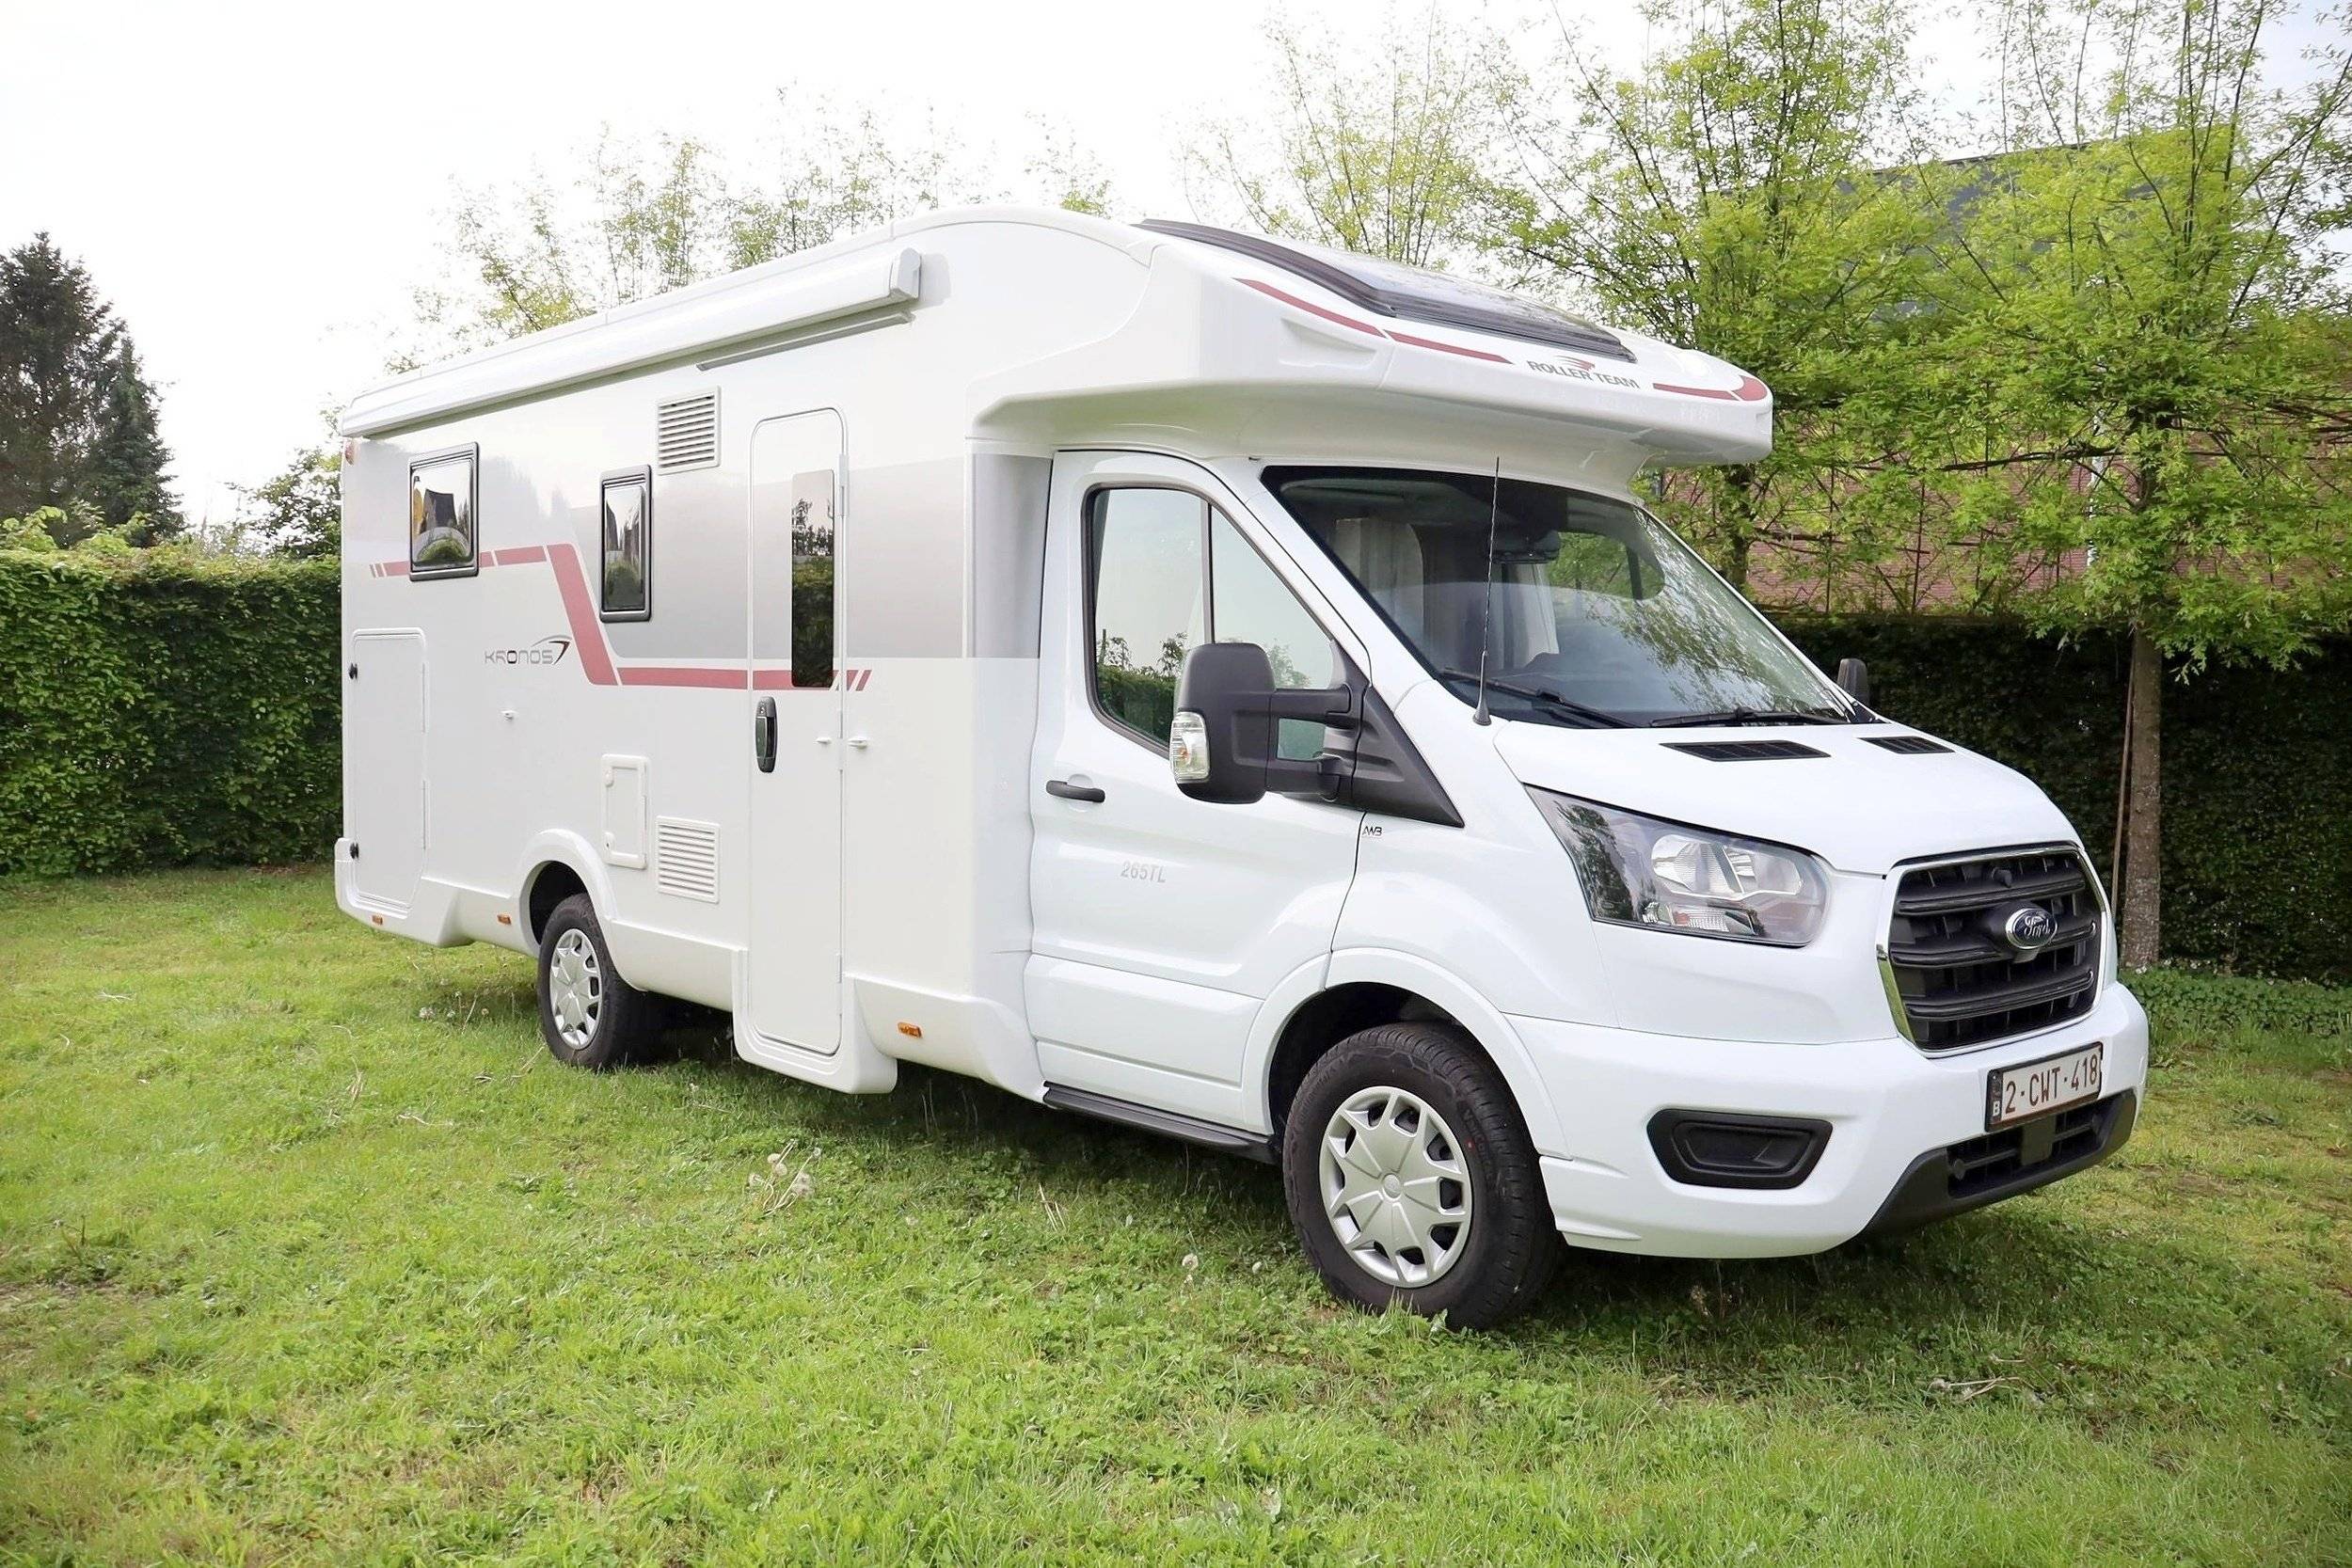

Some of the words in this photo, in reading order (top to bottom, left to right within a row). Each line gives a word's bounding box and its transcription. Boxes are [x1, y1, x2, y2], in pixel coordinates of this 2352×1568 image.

[1526, 360, 1594, 381] ROLLER
[1593, 372, 1641, 388] TEAM
[485, 649, 553, 664] KRONOS
[1120, 861, 1167, 882] 265TL
[2024, 915, 2051, 939] Ford
[1993, 1101, 2000, 1117] B
